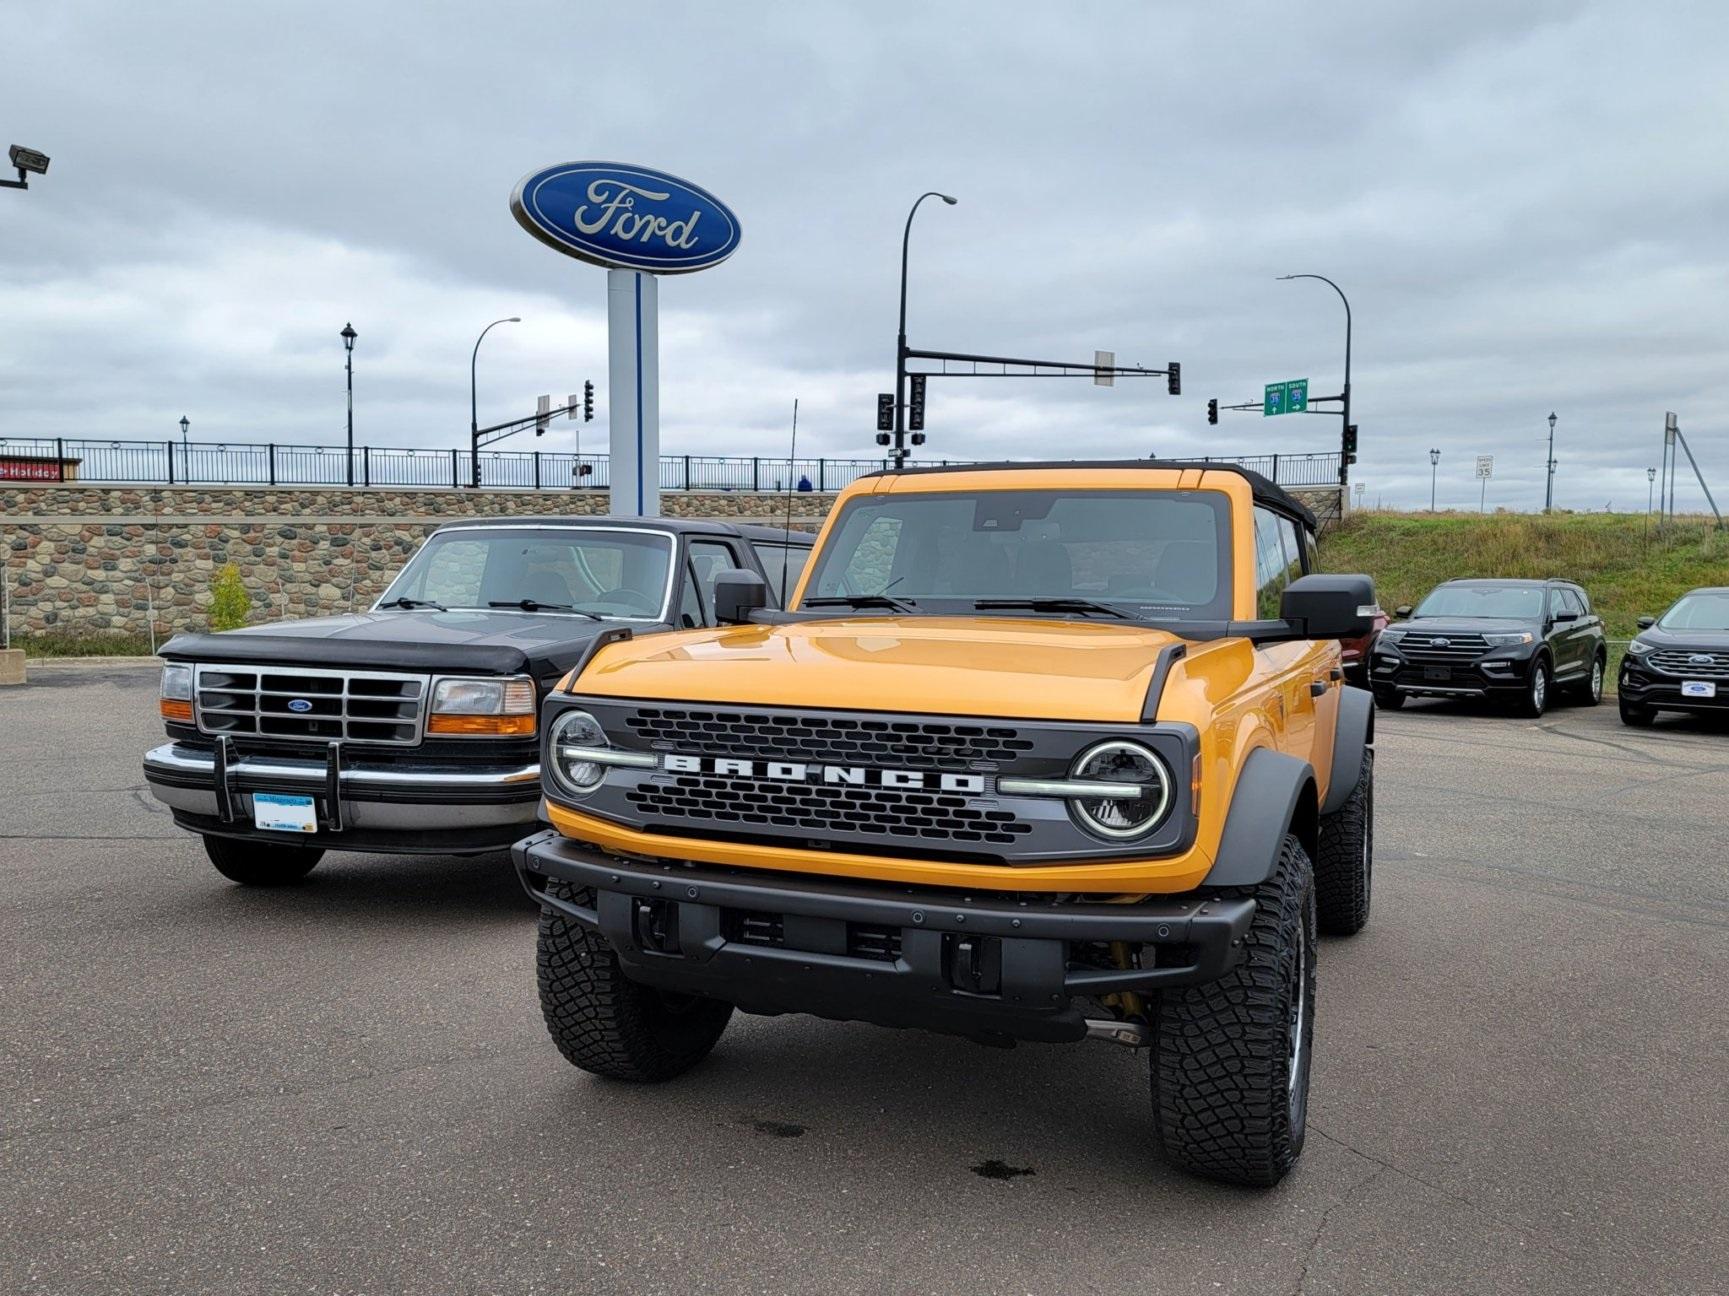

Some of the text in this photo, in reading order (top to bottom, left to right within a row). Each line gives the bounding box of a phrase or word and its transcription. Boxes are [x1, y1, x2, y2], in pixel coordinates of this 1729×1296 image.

[574, 179, 702, 250] Ford
[1288, 381, 1307, 389] SOUTH
[10, 467, 59, 479] Holiday
[1478, 468, 1491, 476] 35
[664, 754, 985, 793] BRONCO
